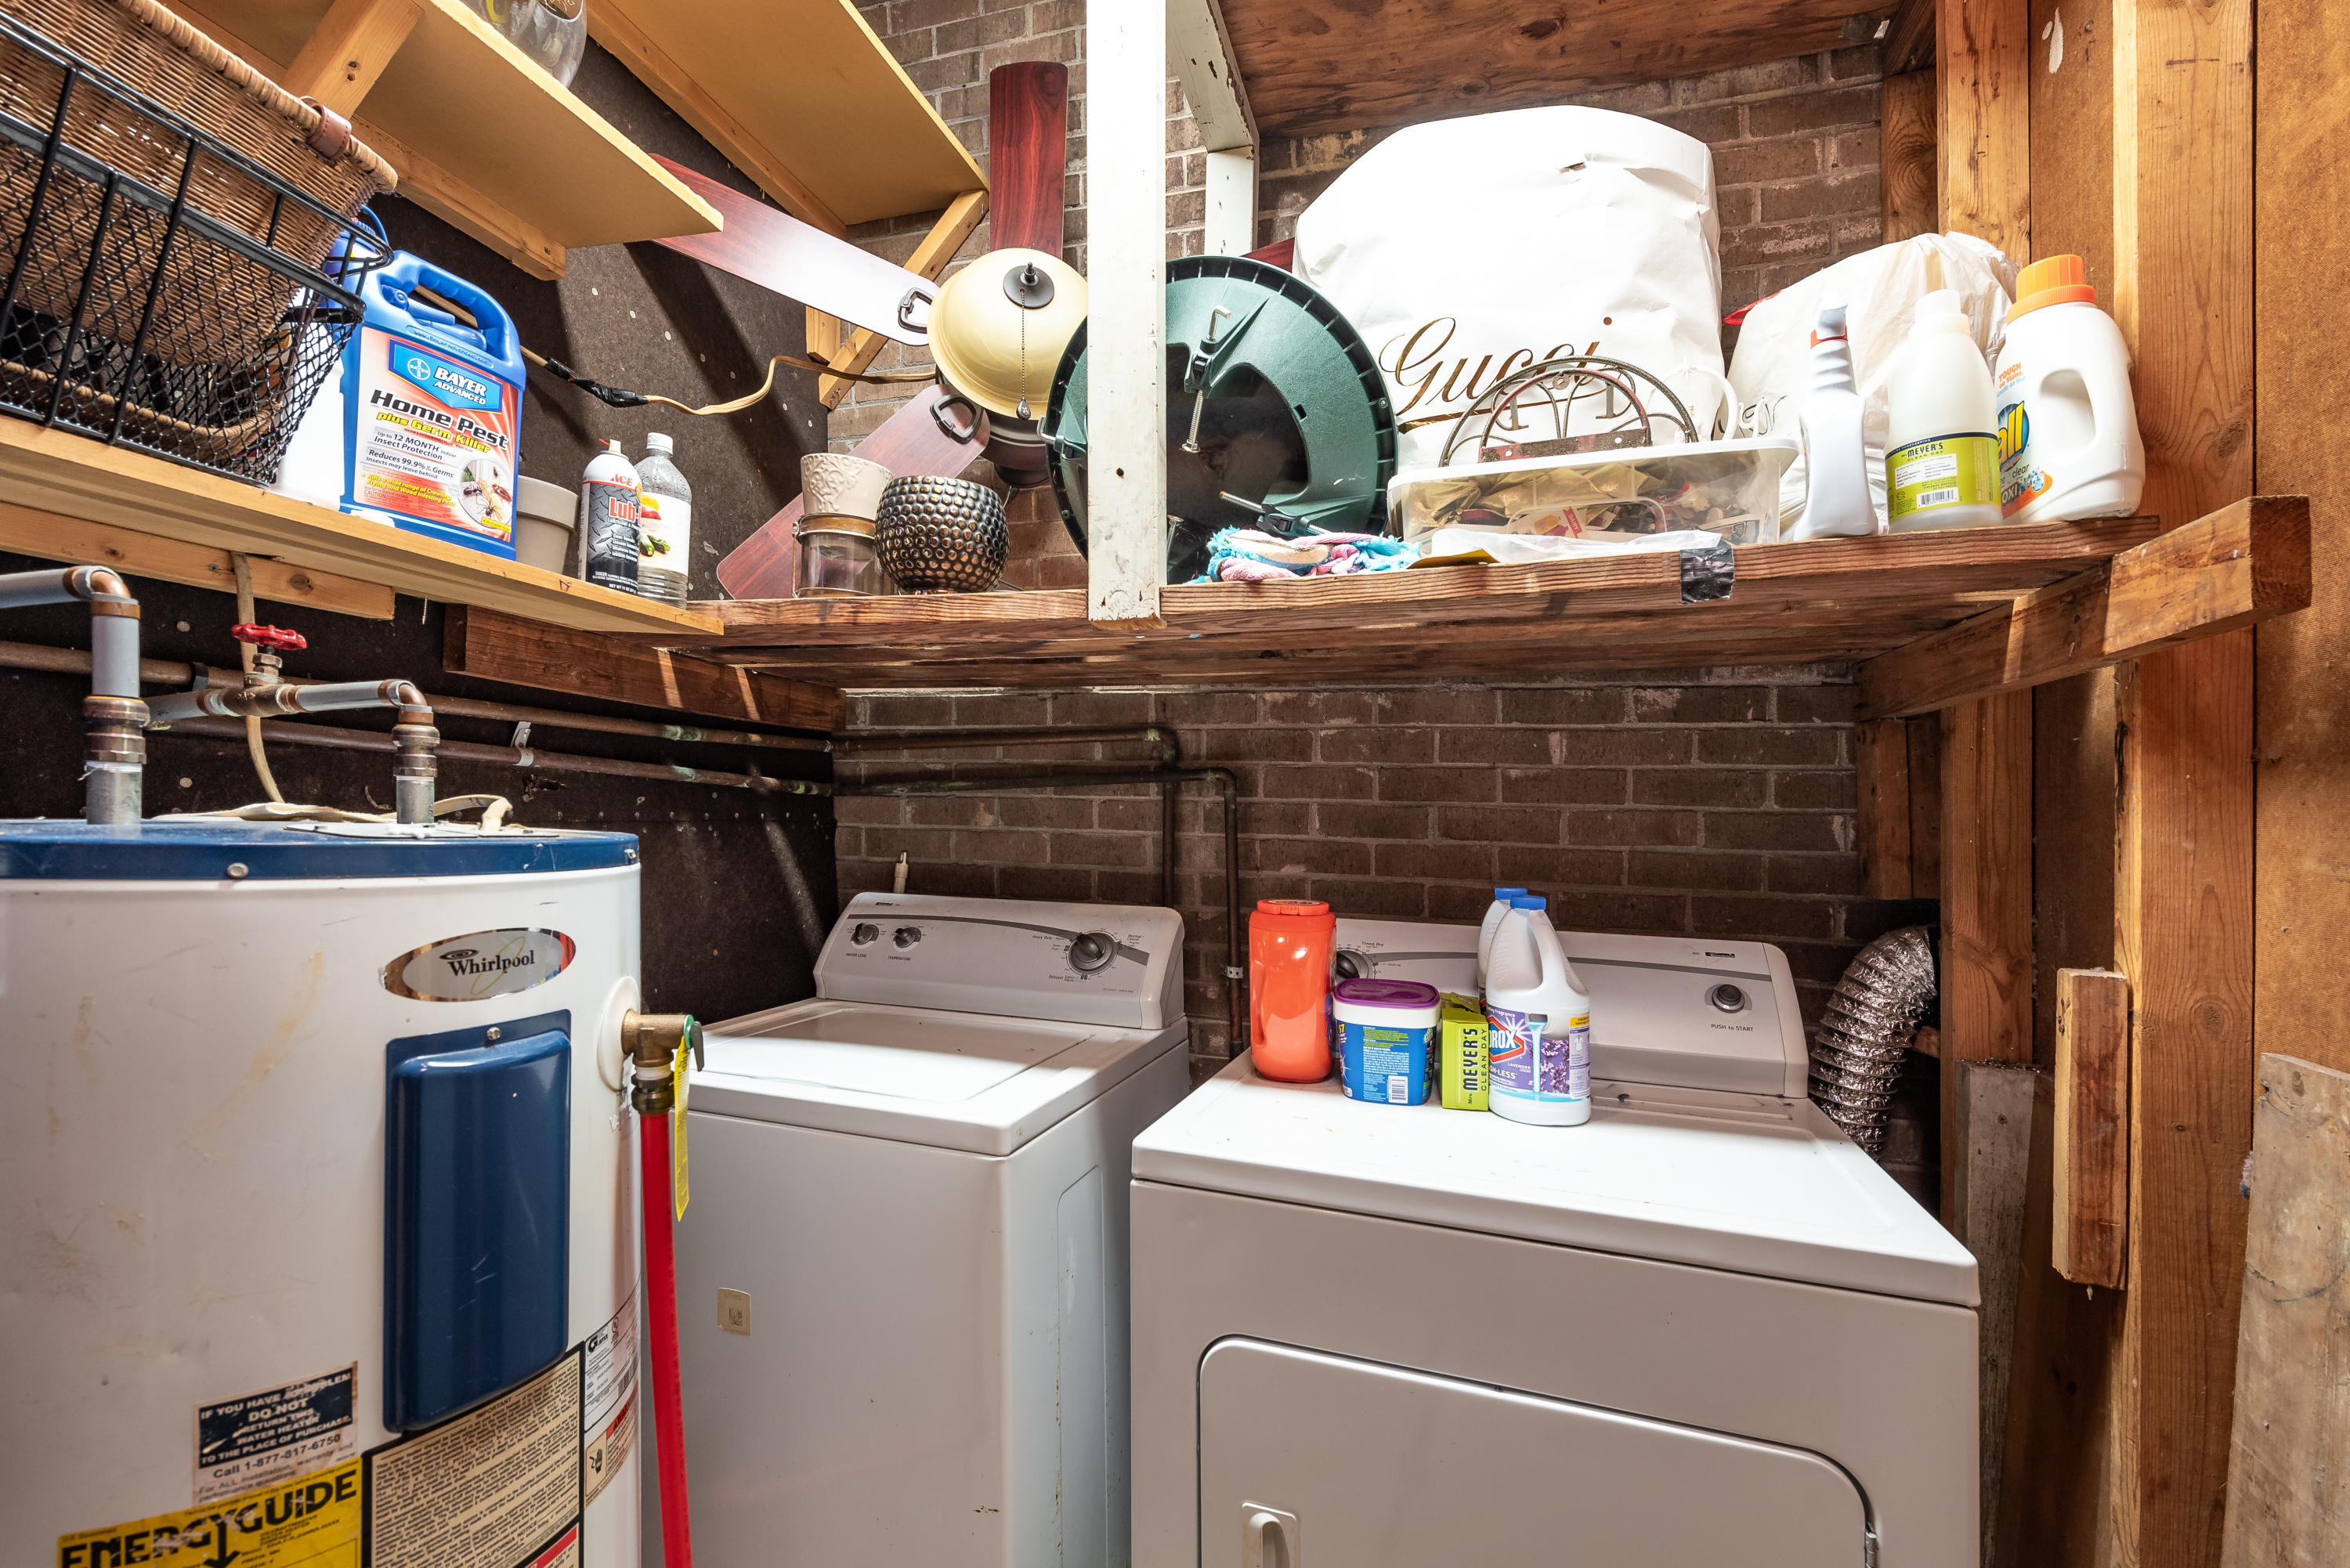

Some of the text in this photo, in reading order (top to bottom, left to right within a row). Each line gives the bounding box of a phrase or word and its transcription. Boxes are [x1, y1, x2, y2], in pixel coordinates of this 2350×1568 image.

[1379, 316, 1617, 417] Gucci
[1998, 362, 2022, 383] TOUGH
[433, 381, 486, 406] ADVANCED
[434, 366, 488, 397] BAYER
[371, 389, 452, 427] Home
[457, 417, 508, 450] Pest
[376, 412, 408, 425] plus
[411, 420, 452, 440] Germ
[455, 433, 491, 453] Killer
[393, 433, 403, 442] 12
[405, 436, 439, 453] MONTH
[1998, 400, 2025, 466] all
[369, 449, 400, 463] Reduces
[402, 457, 425, 470] 99.9%
[374, 436, 401, 449] Insect
[401, 443, 443, 461] Protection
[1907, 442, 1943, 457] MEYER'S
[389, 461, 401, 471] may
[402, 465, 418, 475] leave
[418, 469, 438, 479] behind
[610, 473, 633, 486] ACE
[2012, 463, 2030, 479] clear
[367, 473, 381, 482] Kills
[386, 478, 400, 486] wide
[401, 482, 420, 492] range
[367, 479, 386, 489] Flying
[400, 486, 417, 495] Wood
[418, 490, 442, 503] Infesting
[2001, 482, 2018, 503] OXI
[1567, 514, 1579, 530] DAIRY
[447, 949, 535, 977] Whirlpool
[1462, 1028, 1479, 1092] MEYER'S
[201, 1410, 213, 1420] IF
[216, 1404, 244, 1418] YOU
[247, 1394, 281, 1409] HAVE
[248, 1398, 309, 1422] DO NOT
[237, 1416, 320, 1446] WATER HEATER
[243, 1416, 287, 1433] RETURN
[201, 1454, 217, 1465] TO
[219, 1449, 240, 1461] THE
[243, 1440, 277, 1454] PLACE
[280, 1434, 294, 1443] OF
[213, 1465, 240, 1479] Call
[219, 1479, 237, 1489] ALL
[478, 1519, 537, 1564] CALIFORNIA NOTICE
